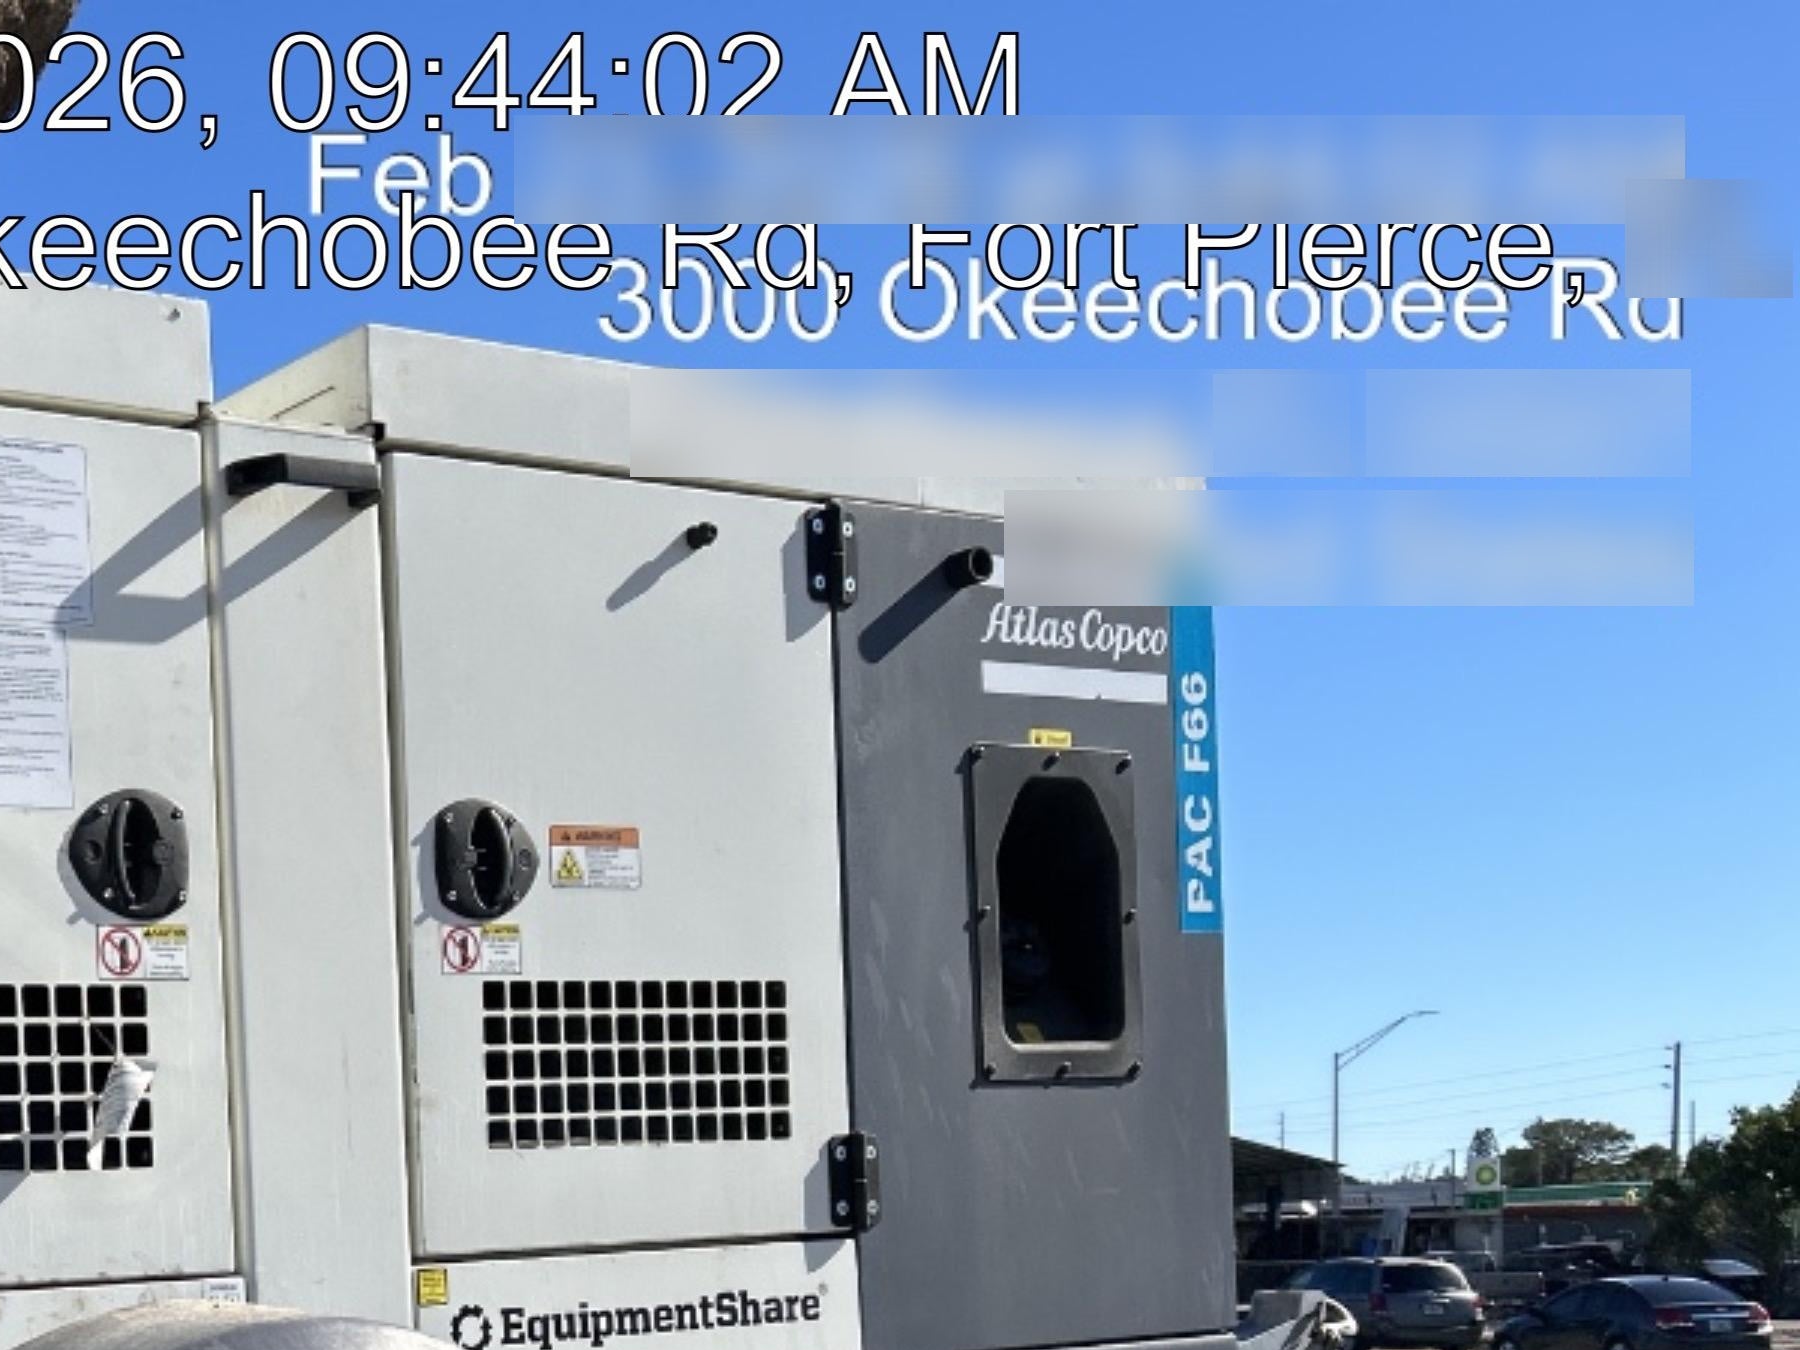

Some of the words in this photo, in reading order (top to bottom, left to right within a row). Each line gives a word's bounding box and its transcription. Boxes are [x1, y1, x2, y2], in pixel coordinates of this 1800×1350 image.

[981, 602, 1075, 649] Atlas
[1078, 608, 1168, 662] Copco
[1181, 671, 1210, 773] F66
[1184, 794, 1214, 913] PAC
[500, 1290, 821, 1350] EquipmentShare
